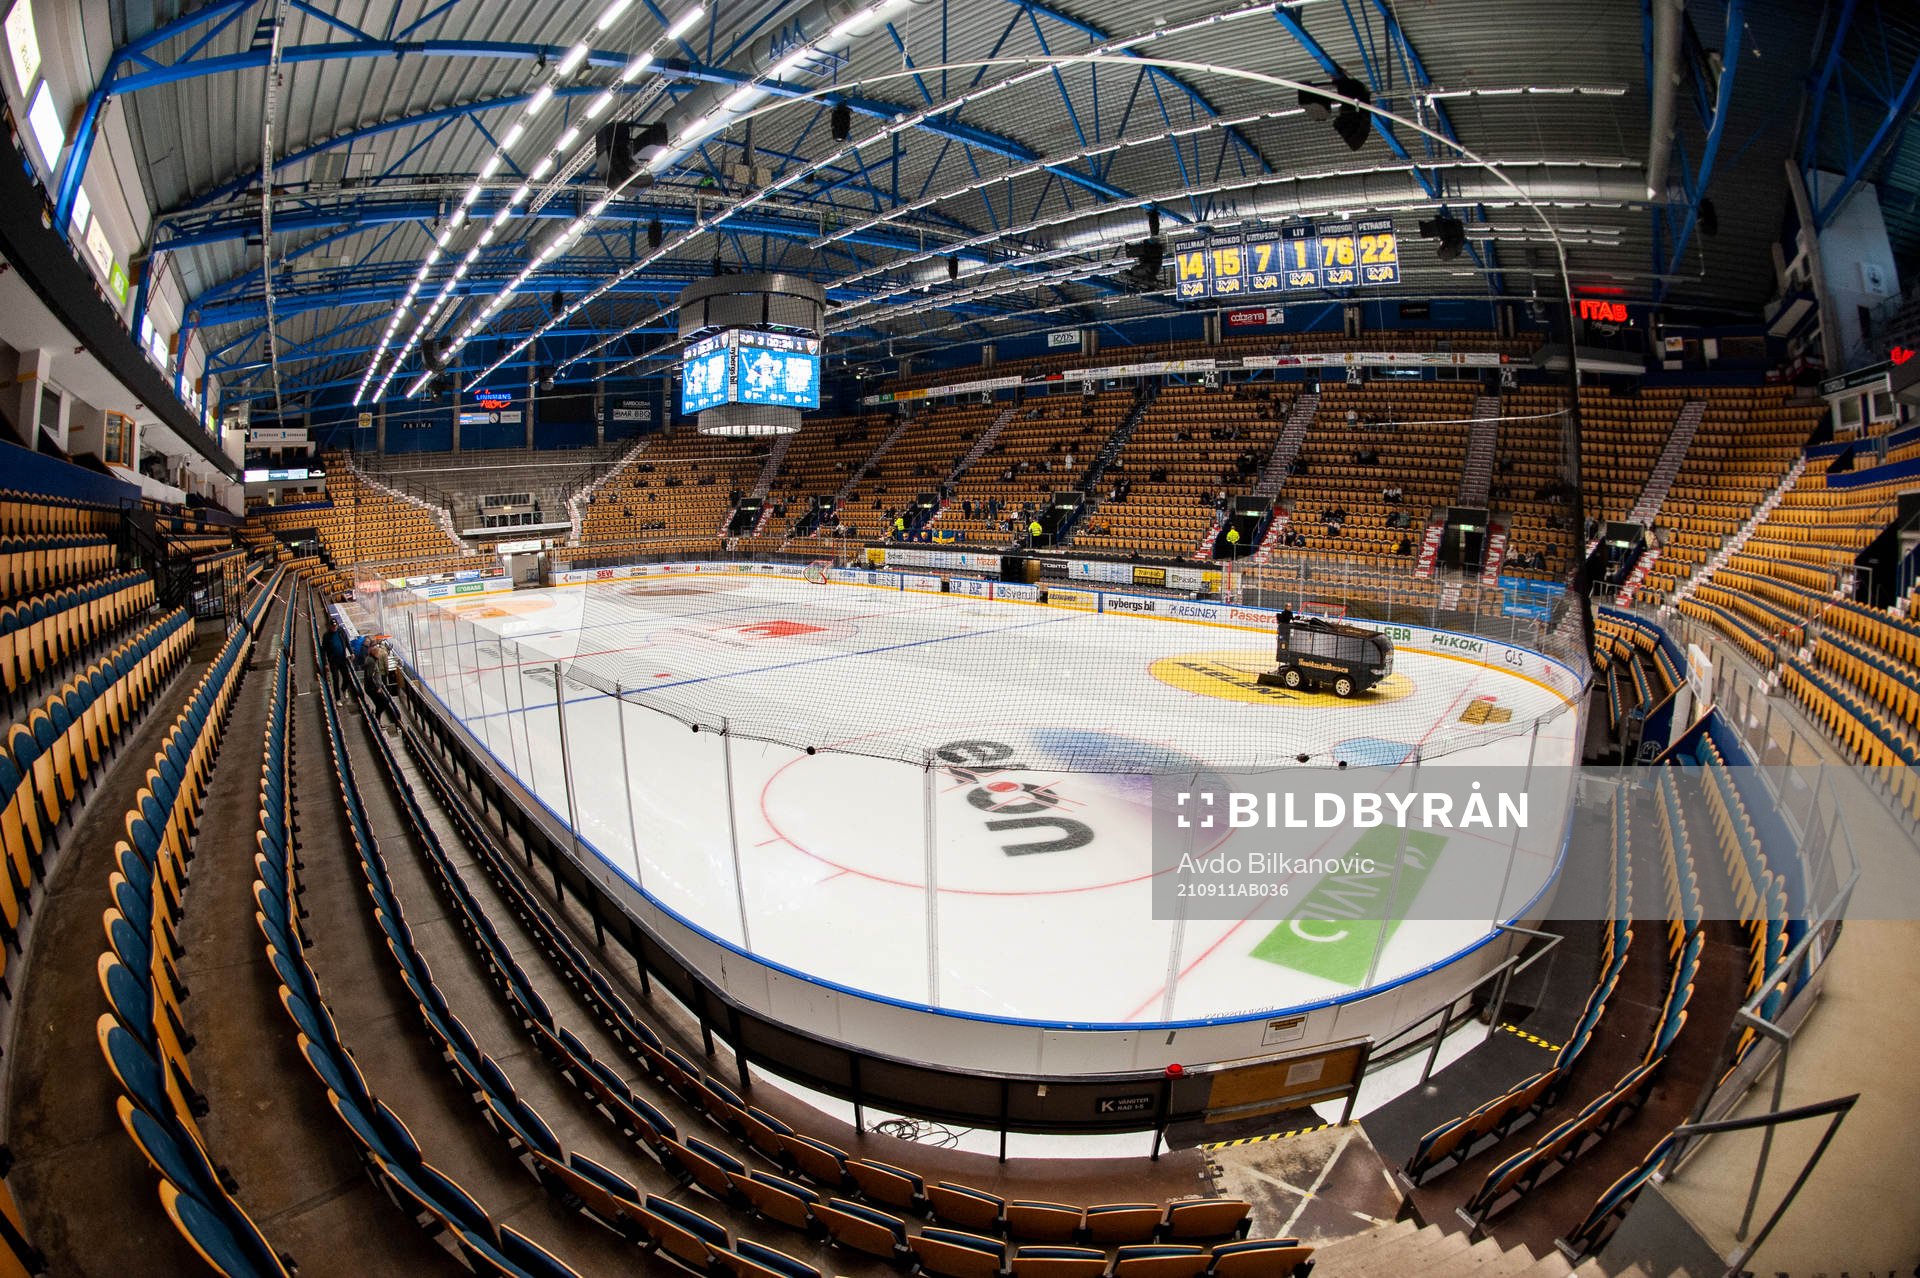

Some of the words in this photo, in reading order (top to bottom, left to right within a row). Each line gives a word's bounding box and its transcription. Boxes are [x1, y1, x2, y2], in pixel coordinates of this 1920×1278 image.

[1293, 228, 1304, 236] LIV
[1255, 244, 1272, 272] 7
[1294, 240, 1306, 268] 1
[1321, 237, 1354, 266] 76
[1360, 234, 1396, 264] 22
[1177, 252, 1205, 280] 14
[1213, 247, 1240, 276] 15
[1580, 299, 1628, 322] ITAB
[729, 347, 738, 375] nybergs
[730, 376, 738, 384] bil
[1108, 598, 1143, 612] nybergs
[1144, 601, 1155, 612] bil
[1179, 605, 1217, 620] RESINEX
[1432, 634, 1484, 653] HiKOKI
[1505, 649, 1523, 666] GLS
[1102, 1100, 1114, 1112] K
